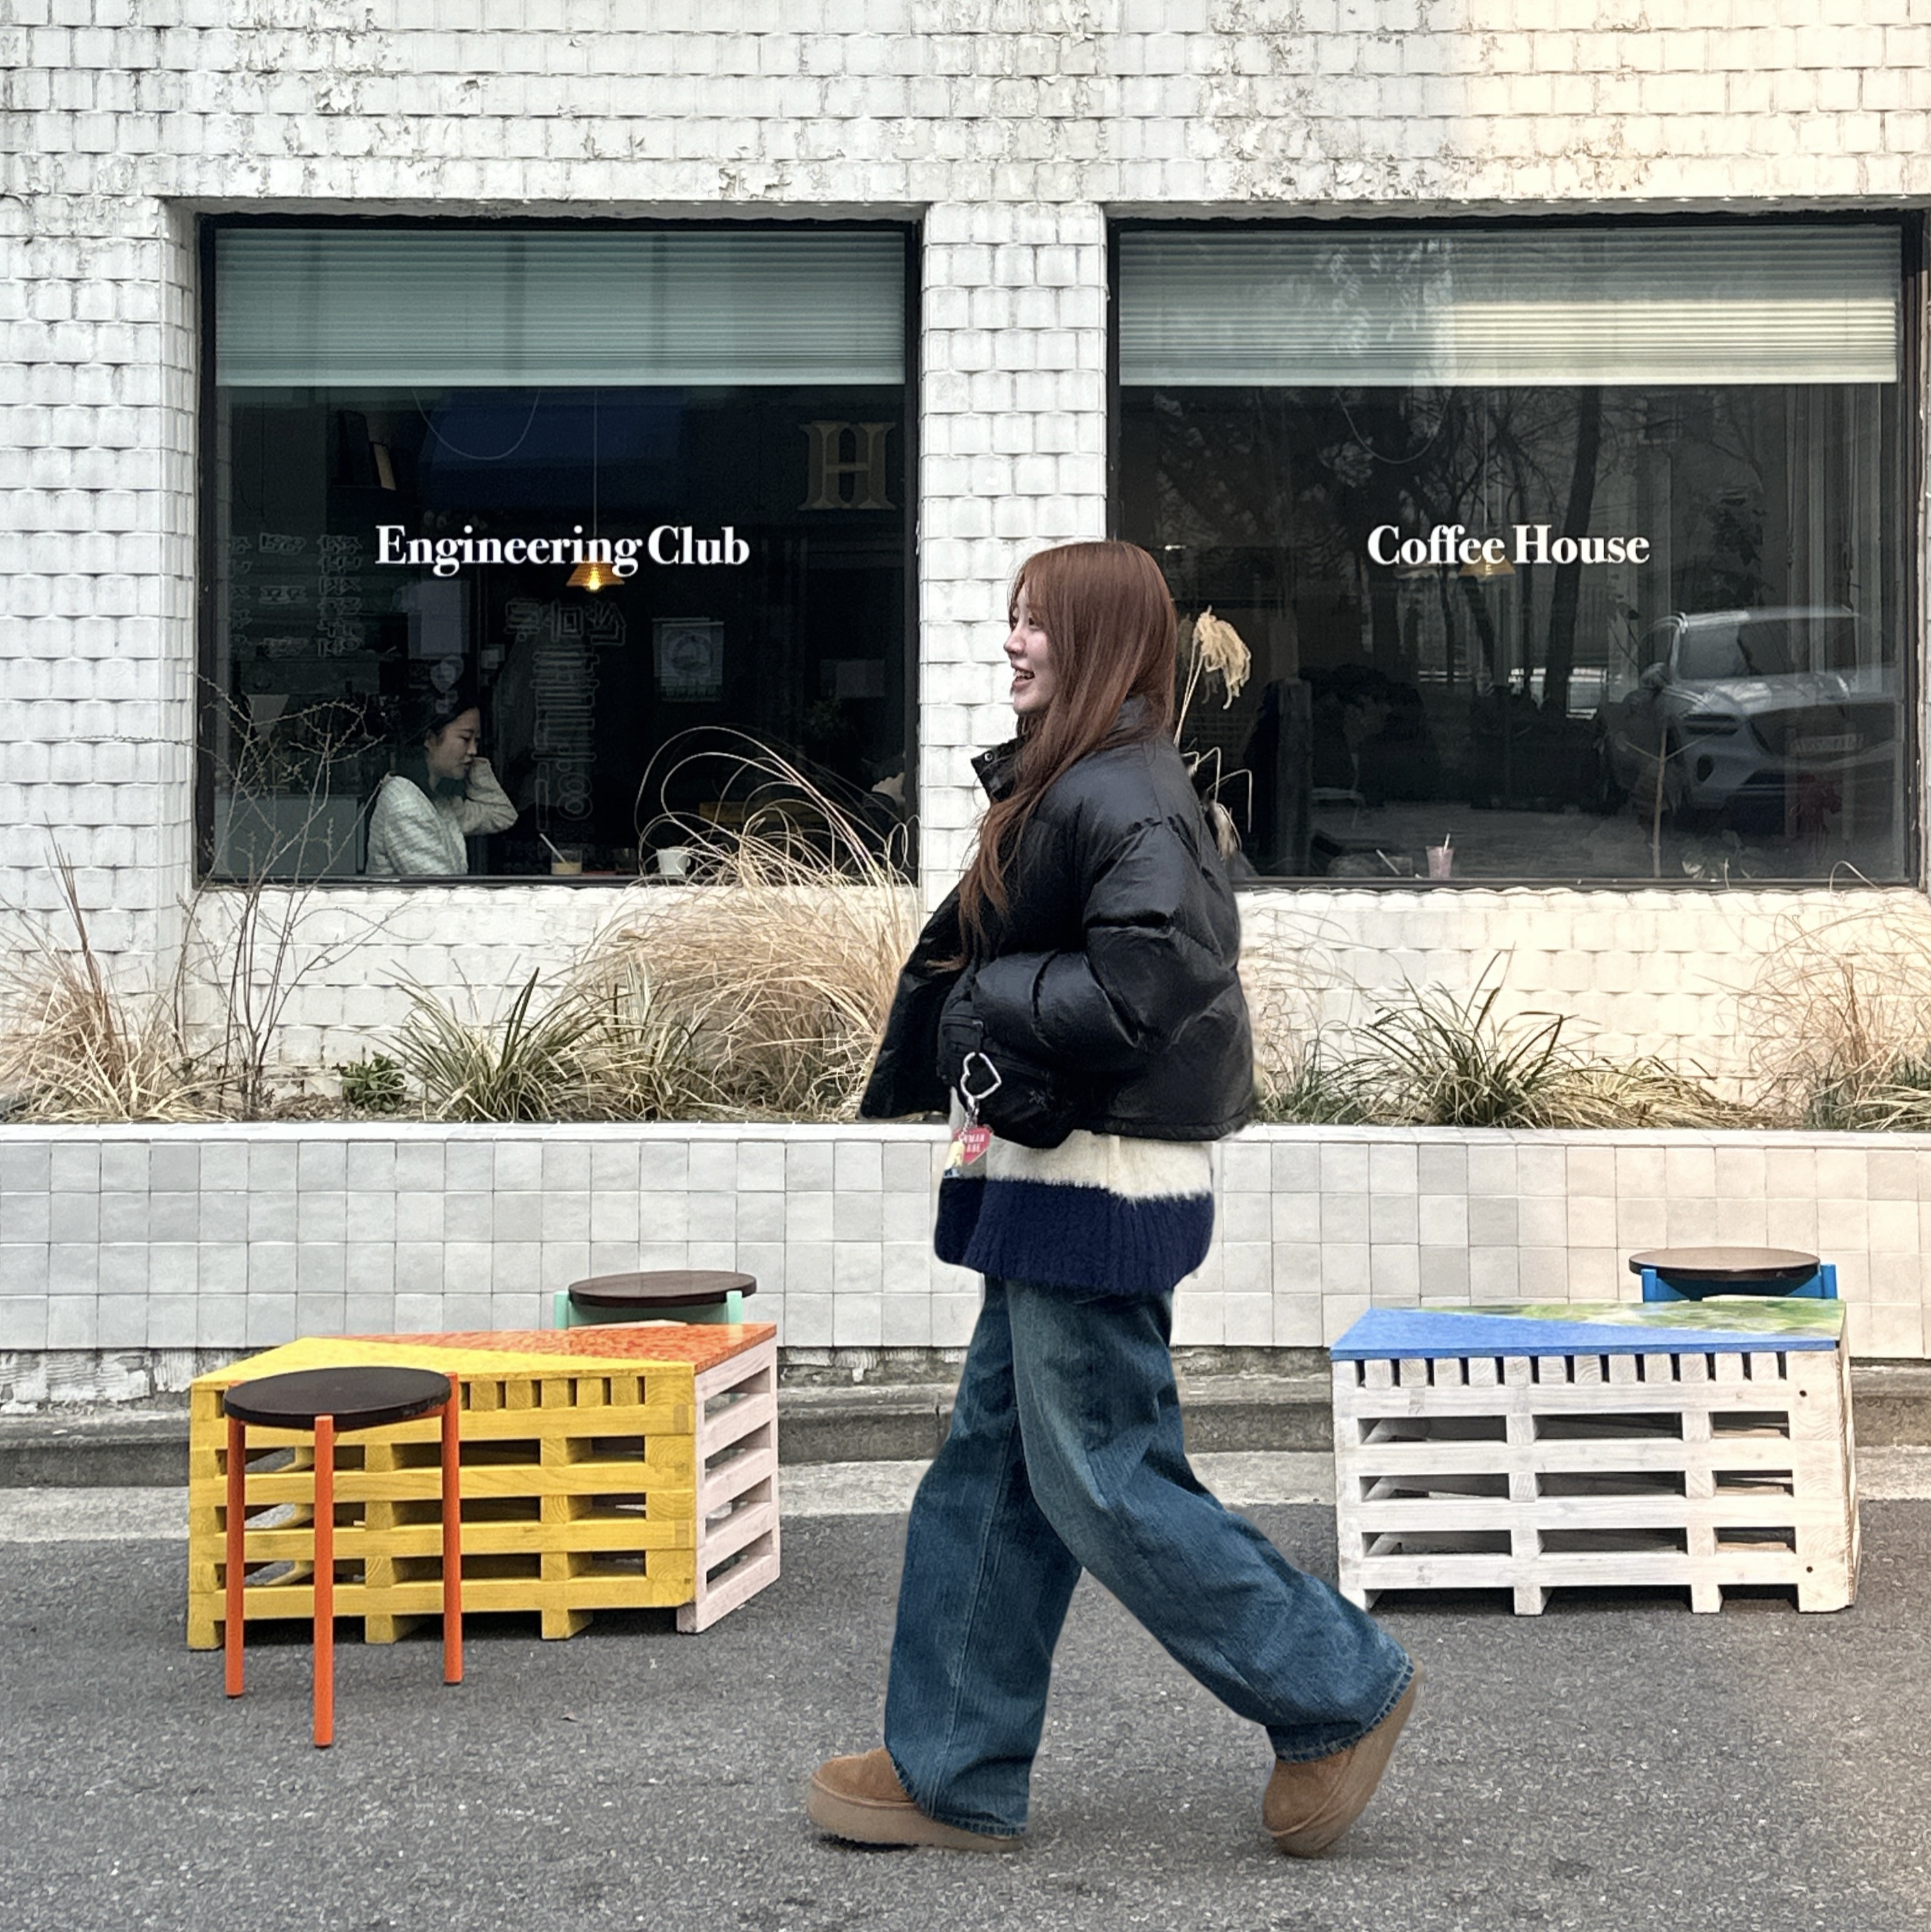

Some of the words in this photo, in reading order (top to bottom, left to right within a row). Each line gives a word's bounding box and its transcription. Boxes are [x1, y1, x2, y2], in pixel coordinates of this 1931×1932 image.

[796, 420, 897, 510] H
[376, 525, 643, 577] Engineering
[648, 525, 750, 565] Club
[1367, 524, 1506, 564] Coffee
[1513, 524, 1650, 564] House
